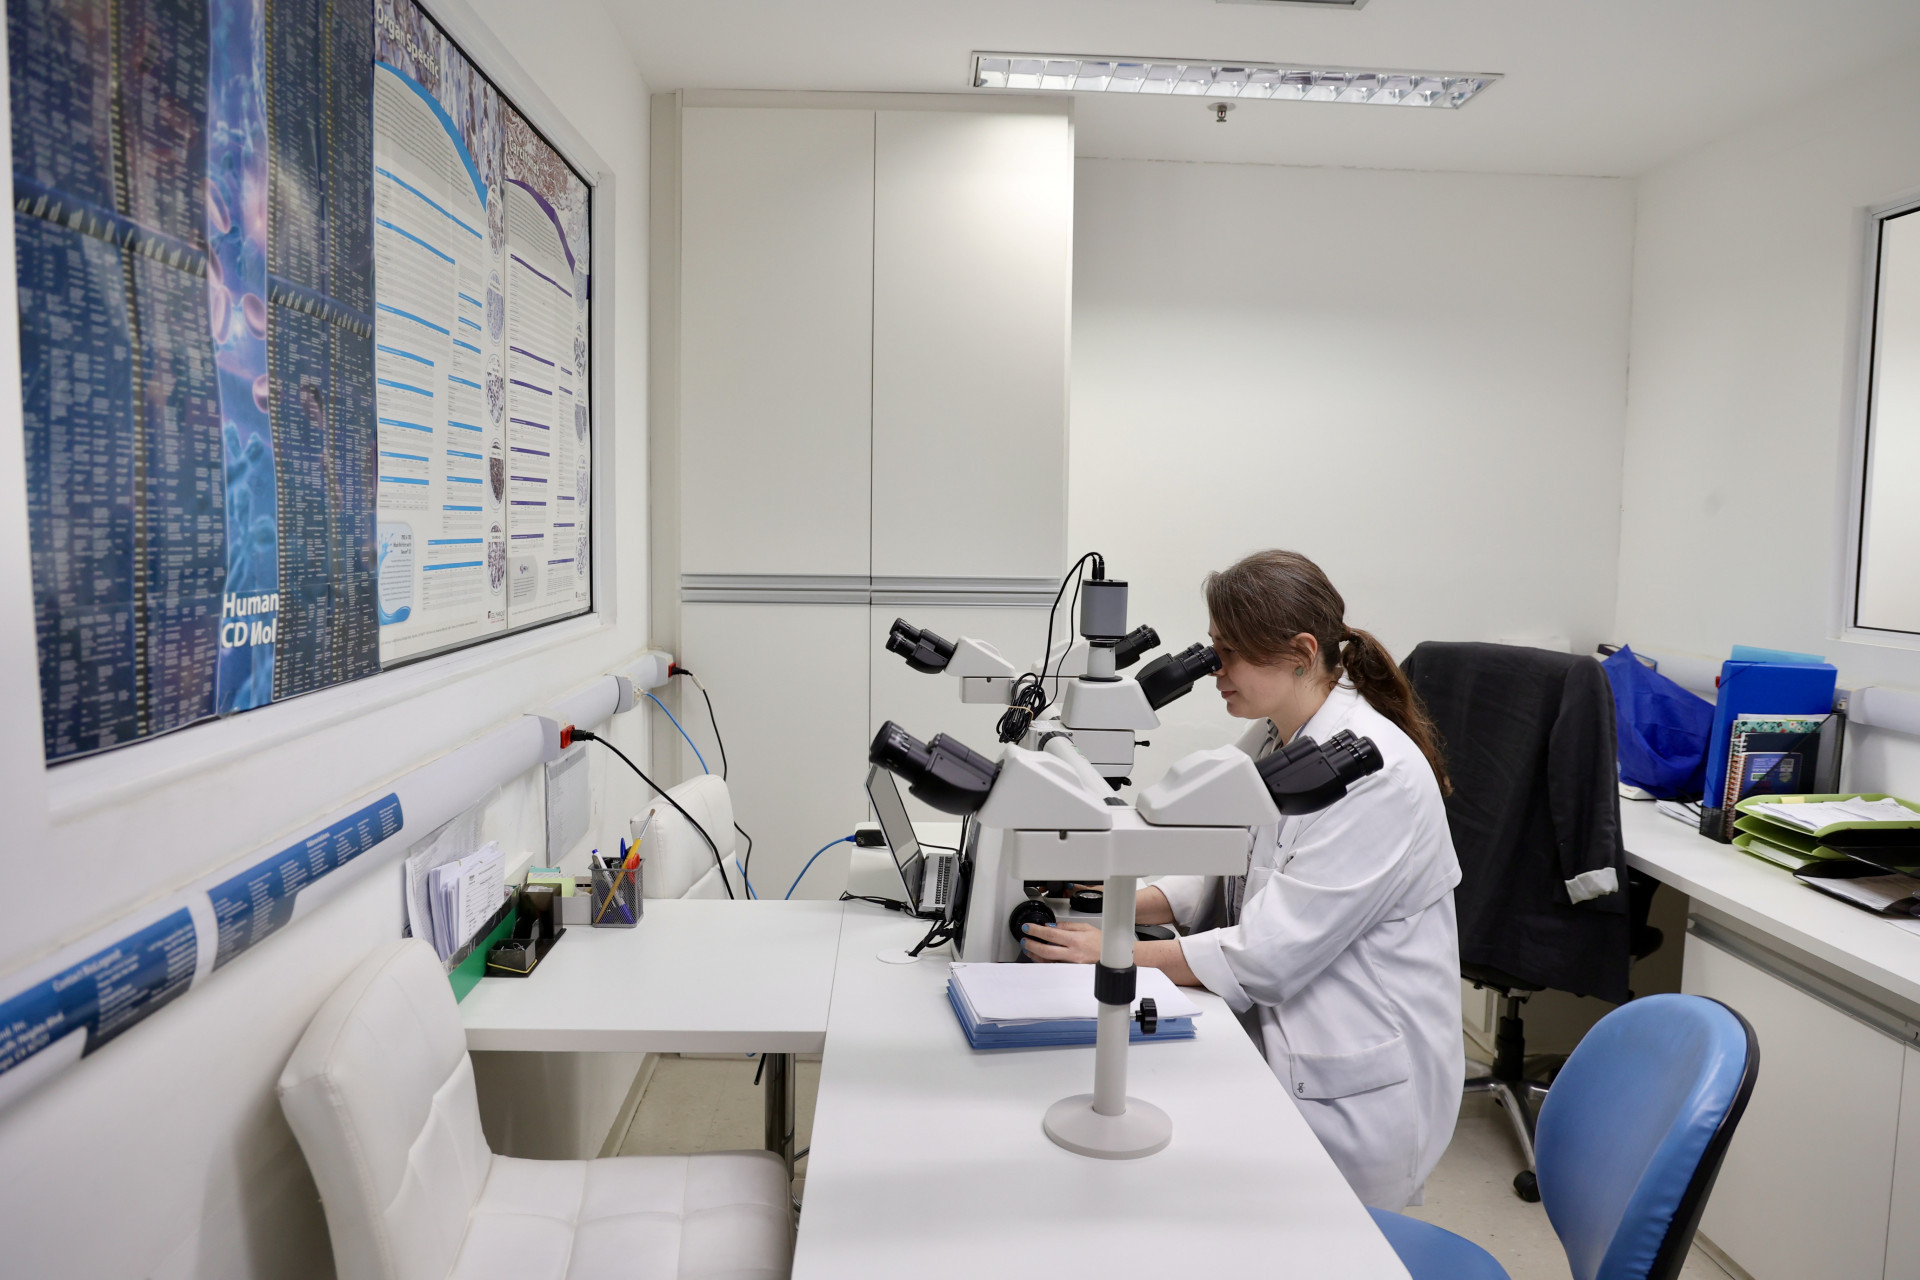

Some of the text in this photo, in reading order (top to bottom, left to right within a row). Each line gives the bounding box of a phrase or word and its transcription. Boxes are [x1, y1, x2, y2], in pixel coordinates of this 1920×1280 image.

[376, 4, 439, 79] Organ Specific
[222, 592, 280, 618] Human
[221, 621, 248, 648] CD
